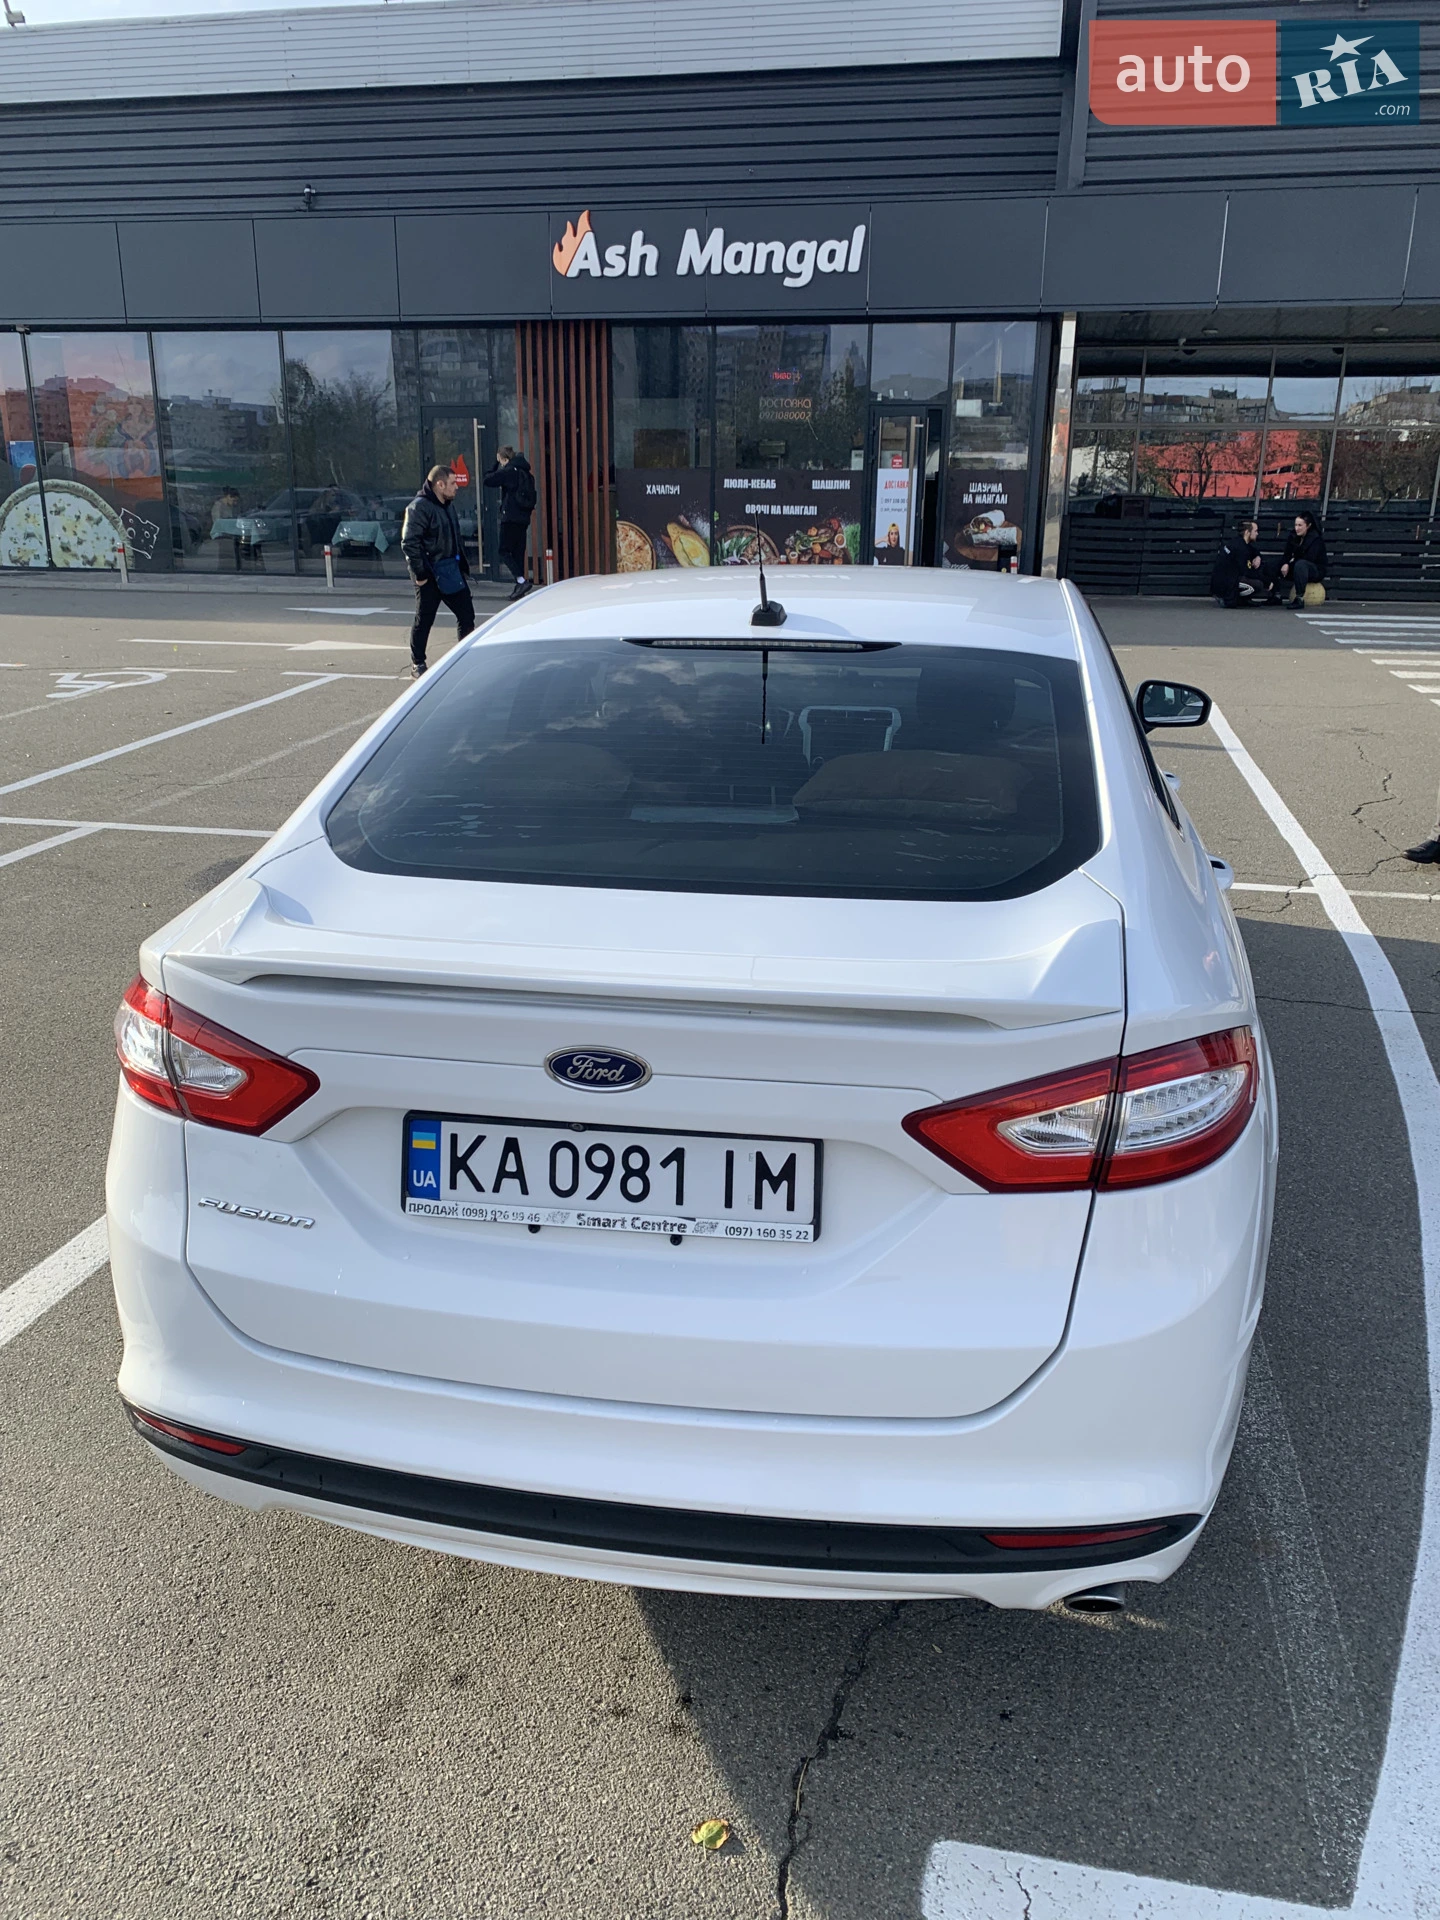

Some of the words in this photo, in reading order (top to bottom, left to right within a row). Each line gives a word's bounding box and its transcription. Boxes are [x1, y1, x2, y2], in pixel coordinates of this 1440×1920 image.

[566, 230, 659, 278] Ash
[676, 224, 866, 288] Mangal
[723, 478, 777, 489] ЛЮЛЯ-КЕБАБ
[811, 479, 851, 490] ШАШЛИК
[969, 482, 1003, 493] ШАУРМА
[962, 493, 973, 505] НА
[975, 494, 1008, 505] МАНГАЛІ
[745, 504, 769, 514] ОВОЧІ
[771, 505, 781, 515] НА
[782, 505, 818, 516] МАНГАЛІ
[566, 1055, 626, 1082] Ford
[413, 1169, 437, 1188] UA
[449, 1132, 530, 1196] KA
[548, 1140, 686, 1206] 0981
[724, 1150, 797, 1212] IM
[408, 1202, 459, 1217] ПРОДАЖ
[576, 1213, 627, 1229] Smart
[631, 1216, 688, 1234] Centre
[725, 1225, 753, 1237] (097)
[757, 1228, 776, 1239] 160
[795, 1230, 809, 1241] 22
